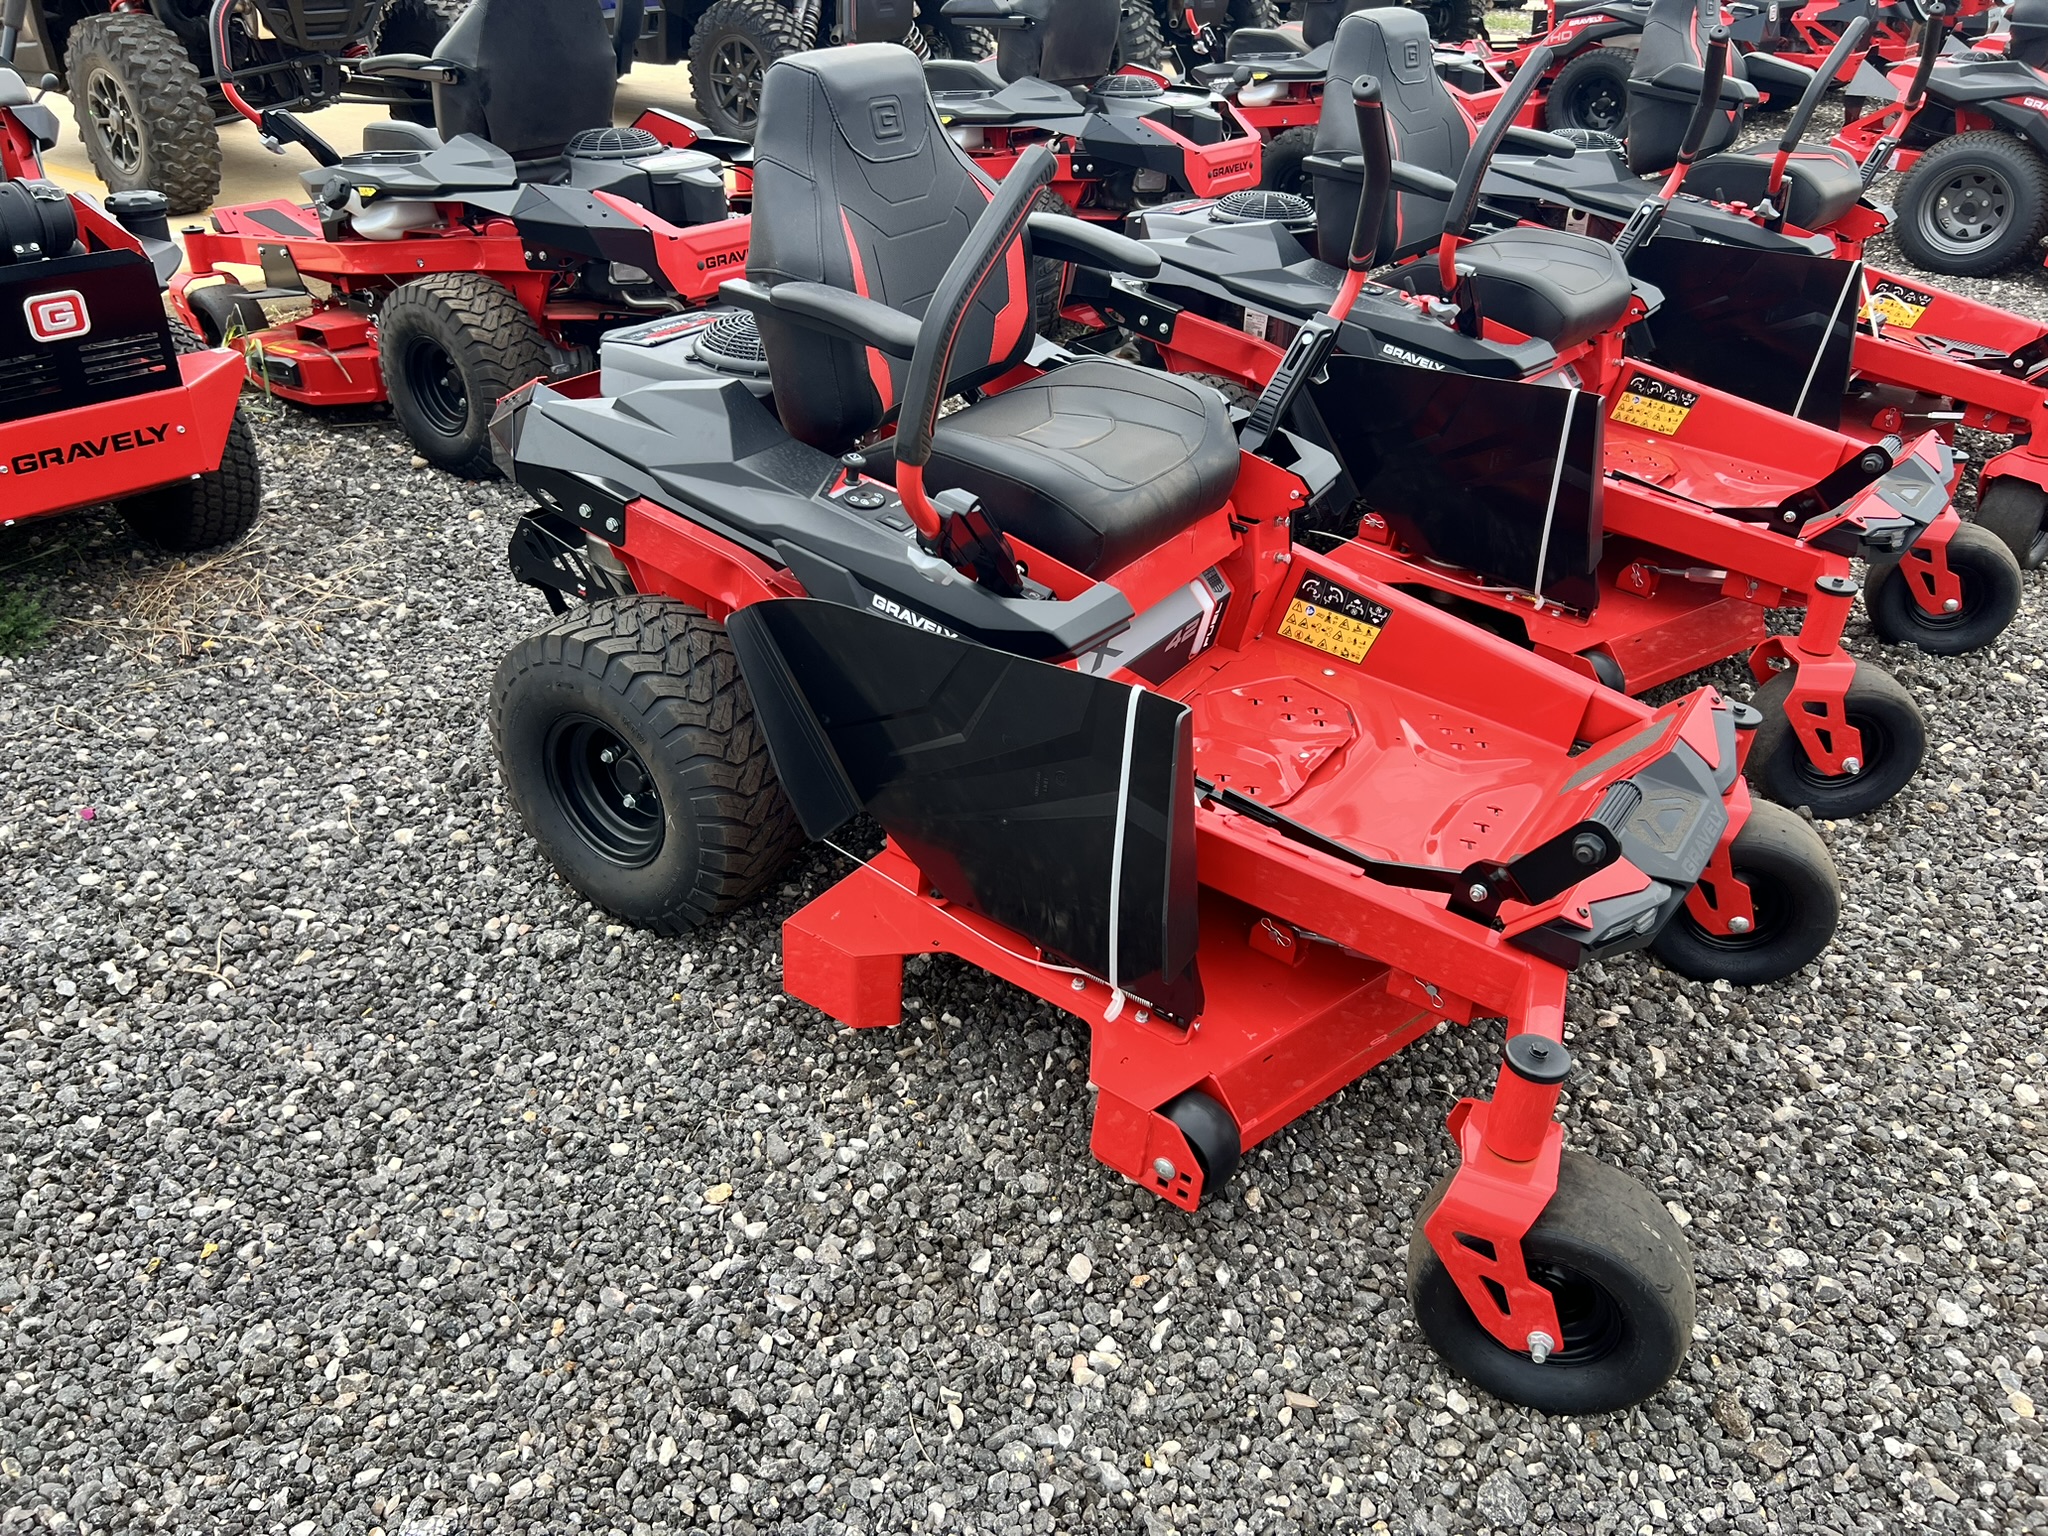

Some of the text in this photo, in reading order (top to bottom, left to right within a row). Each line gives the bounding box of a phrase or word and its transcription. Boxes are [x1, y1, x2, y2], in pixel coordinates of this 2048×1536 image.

[1569, 15, 1604, 27] GRAVELY
[1551, 31, 1573, 43] HD
[1212, 161, 1249, 178] GRAVELY
[706, 249, 749, 269] GRAV
[11, 422, 170, 475] GRAVELY
[1164, 616, 1201, 653] 42
[1203, 601, 1223, 648] FUEL
[1681, 805, 1724, 878] GRAVELY
